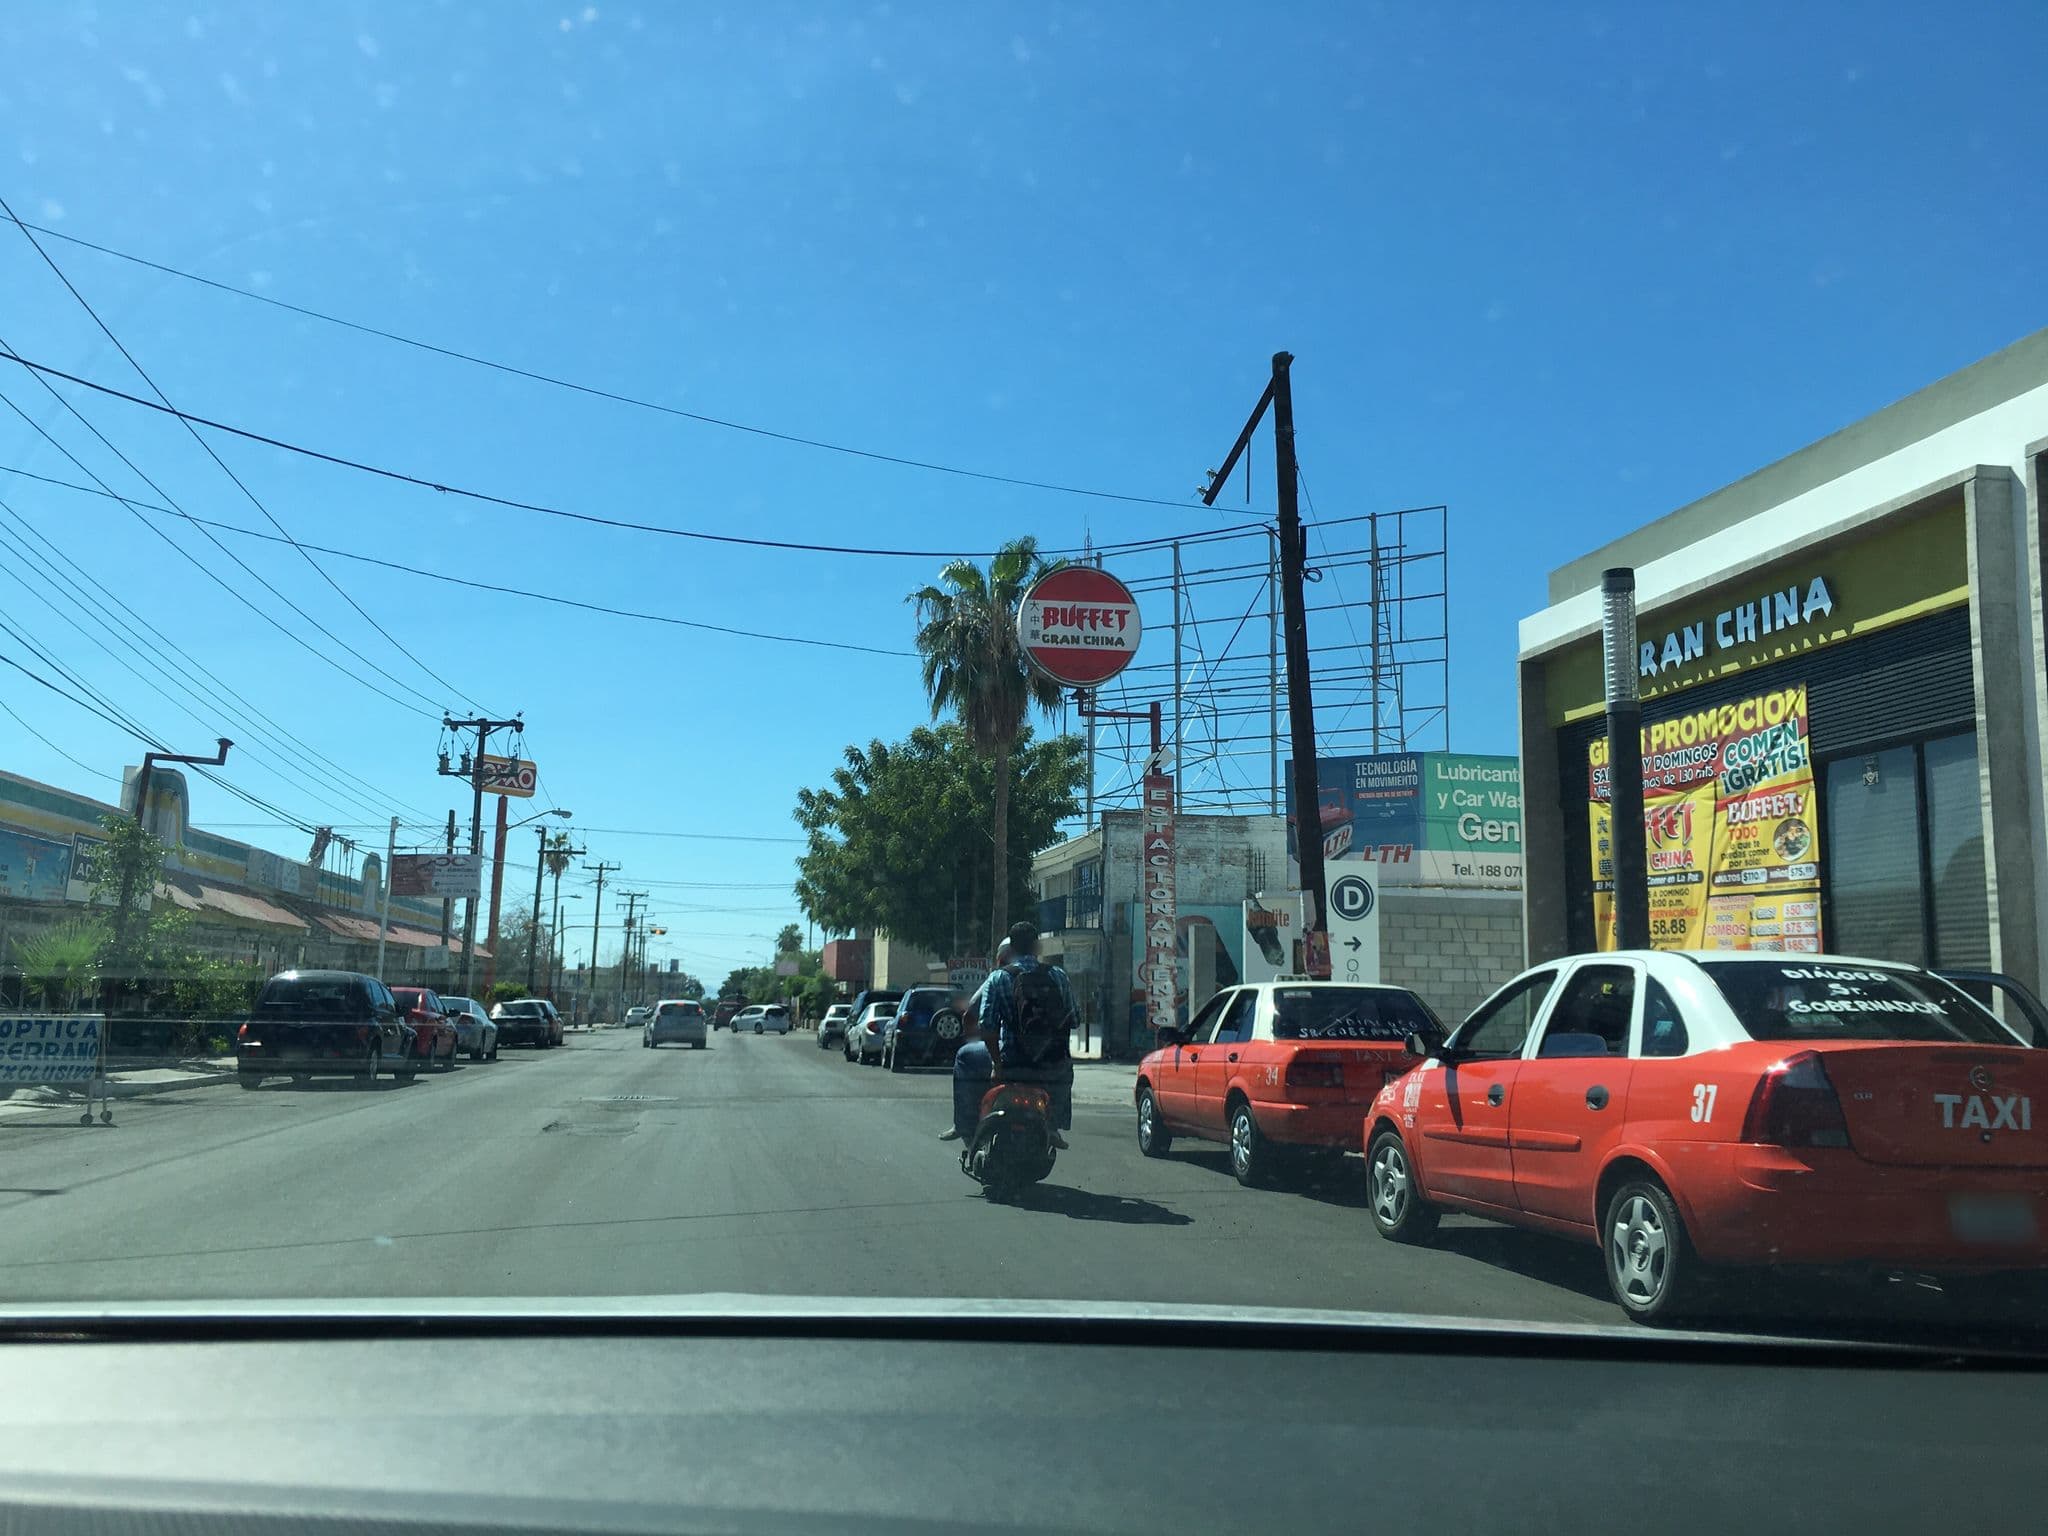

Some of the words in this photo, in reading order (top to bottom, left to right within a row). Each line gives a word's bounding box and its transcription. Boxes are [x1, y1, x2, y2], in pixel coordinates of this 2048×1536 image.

[1041, 604, 1131, 633] BUFFET
[1639, 621, 1704, 678] RAN
[1715, 576, 1832, 649] CHINA
[1041, 633, 1080, 646] GRAN
[1083, 635, 1126, 648] CHINA
[1723, 719, 1798, 768] COMEN
[1355, 757, 1418, 776] TECNOLOGÍA
[1654, 743, 1718, 771] DOMINGOS
[1355, 778, 1366, 789] EN
[1367, 774, 1418, 788] MOVIMIENTO
[1437, 792, 1448, 809] y
[1452, 789, 1485, 807] Car
[1325, 828, 1350, 857] LTH
[1728, 825, 1758, 841] TODO
[1363, 843, 1414, 864] LTH
[1650, 850, 1694, 871] CHINA
[1452, 863, 1474, 876] Tel.
[1478, 865, 1501, 877] 188
[1729, 860, 1742, 868] por
[1677, 873, 1686, 882] La
[1660, 888, 1690, 898] DOMINGO
[1149, 788, 1174, 1027] ESTACIONAMIENTO
[1706, 924, 1747, 936] COMBOS
[1788, 999, 1949, 1015] GOBERNADOR
[0, 1020, 98, 1039] OPTICA
[1691, 1083, 1718, 1124] 37
[1933, 1093, 2032, 1131] TAXI
